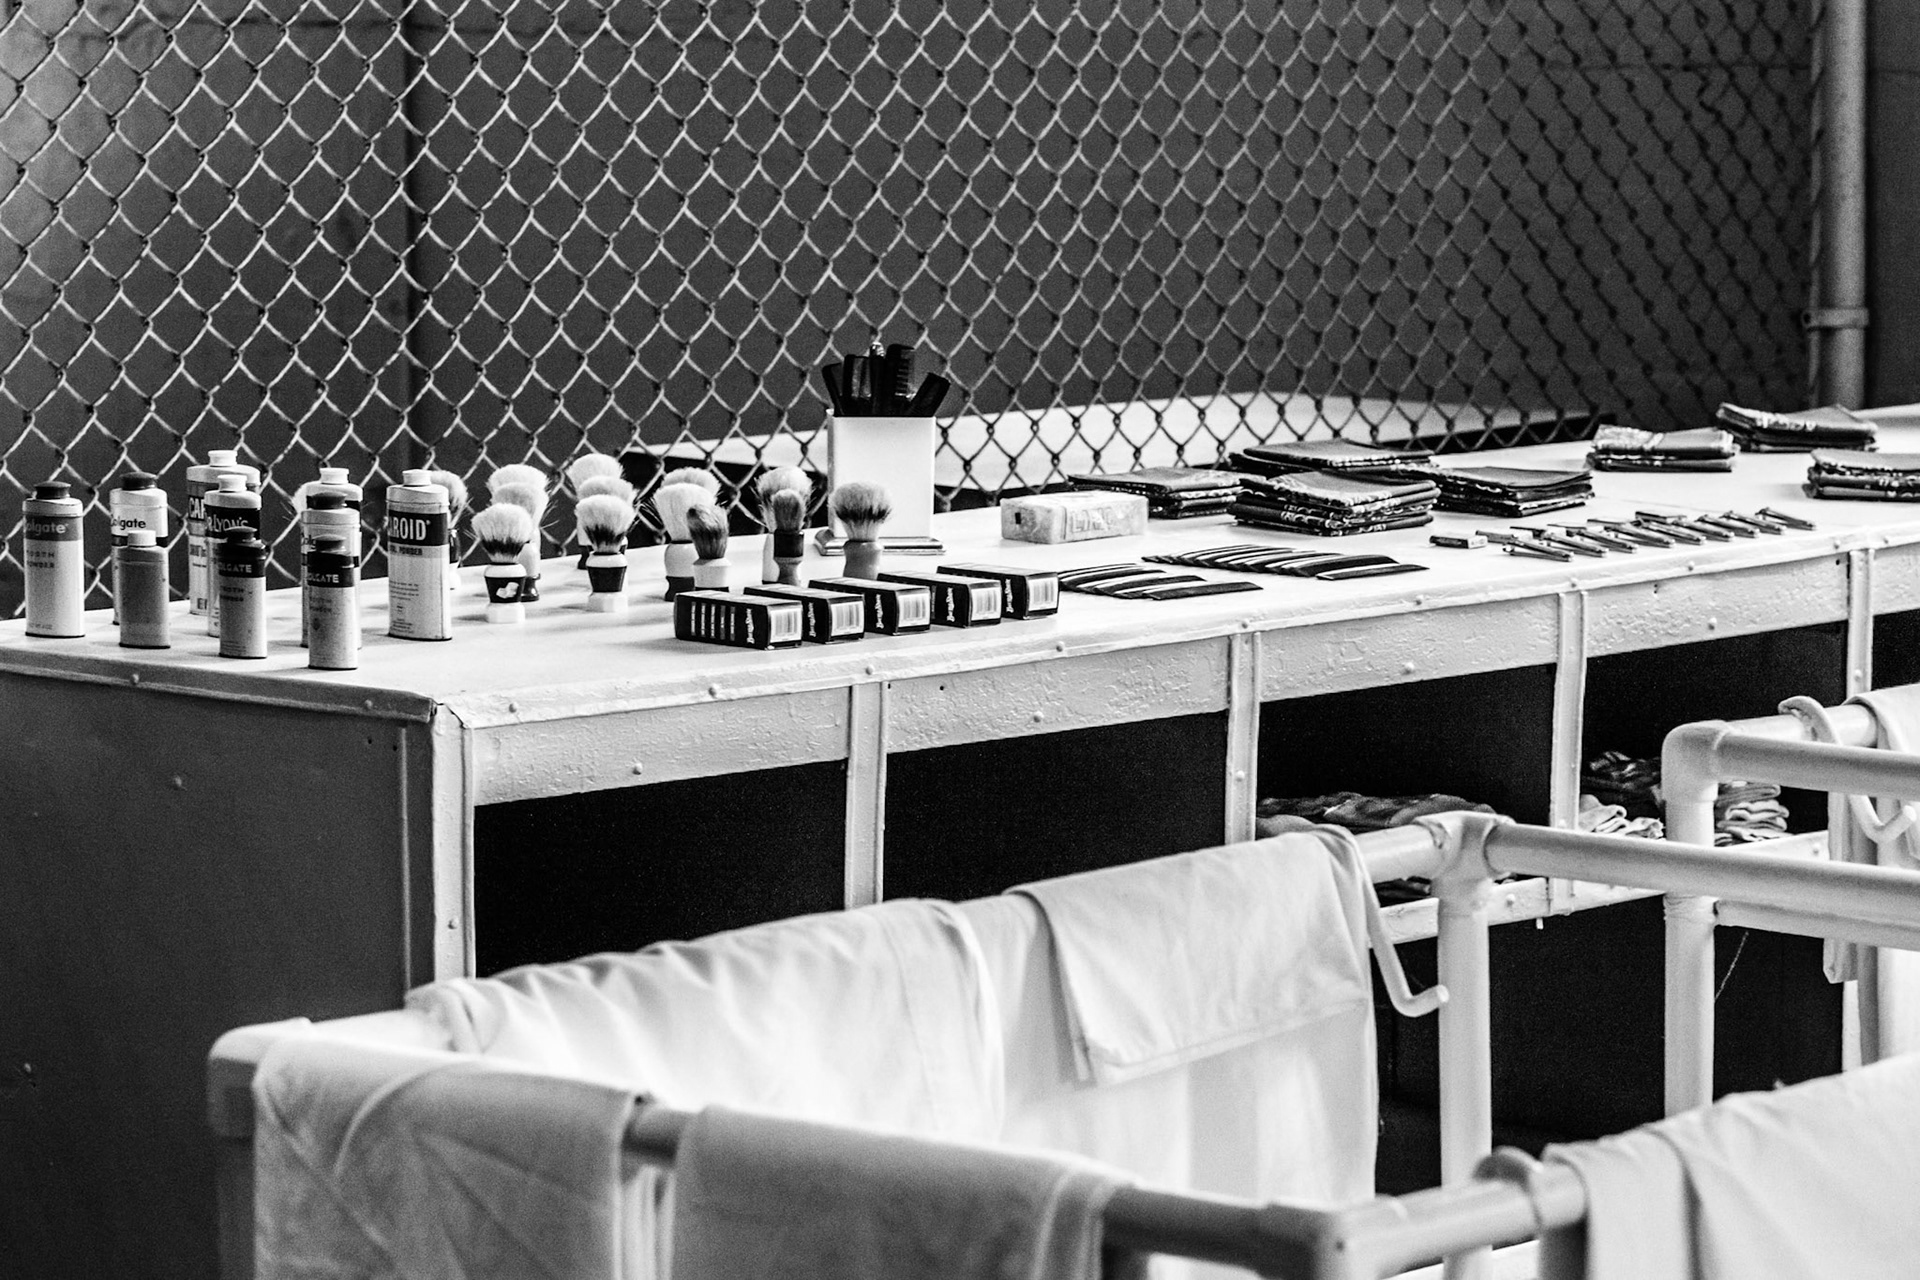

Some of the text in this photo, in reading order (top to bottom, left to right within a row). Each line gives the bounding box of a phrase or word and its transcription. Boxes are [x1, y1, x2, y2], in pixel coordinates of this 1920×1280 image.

[26, 519, 66, 536] olgate
[388, 515, 427, 540] AROID
[219, 562, 252, 574] OLGATE
[307, 573, 340, 583] OLGATE
